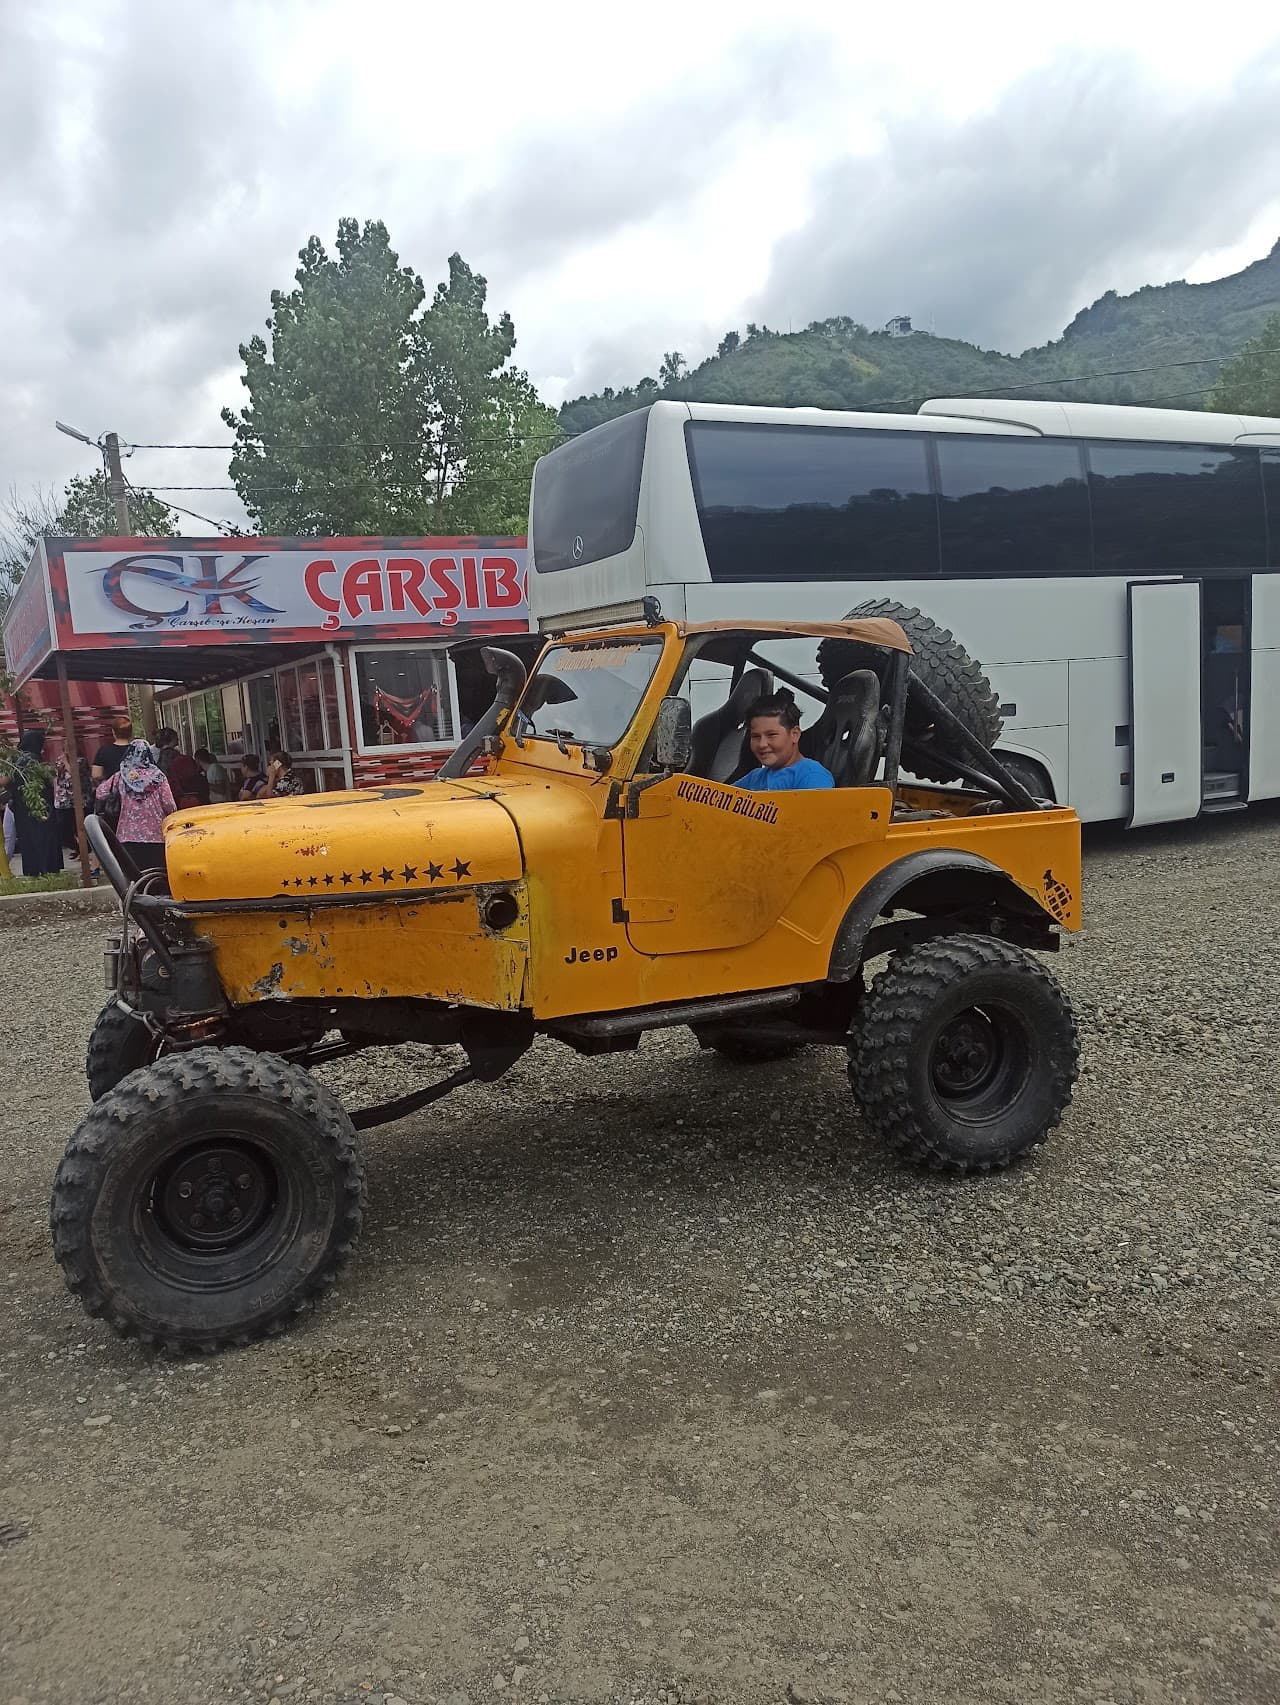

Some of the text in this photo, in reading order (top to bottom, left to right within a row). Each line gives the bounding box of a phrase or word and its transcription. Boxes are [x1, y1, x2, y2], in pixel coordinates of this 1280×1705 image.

[304, 556, 528, 630] ÇARŞIB
[732, 794, 779, 825] BÜLBÜL
[564, 946, 618, 965] Jeep
